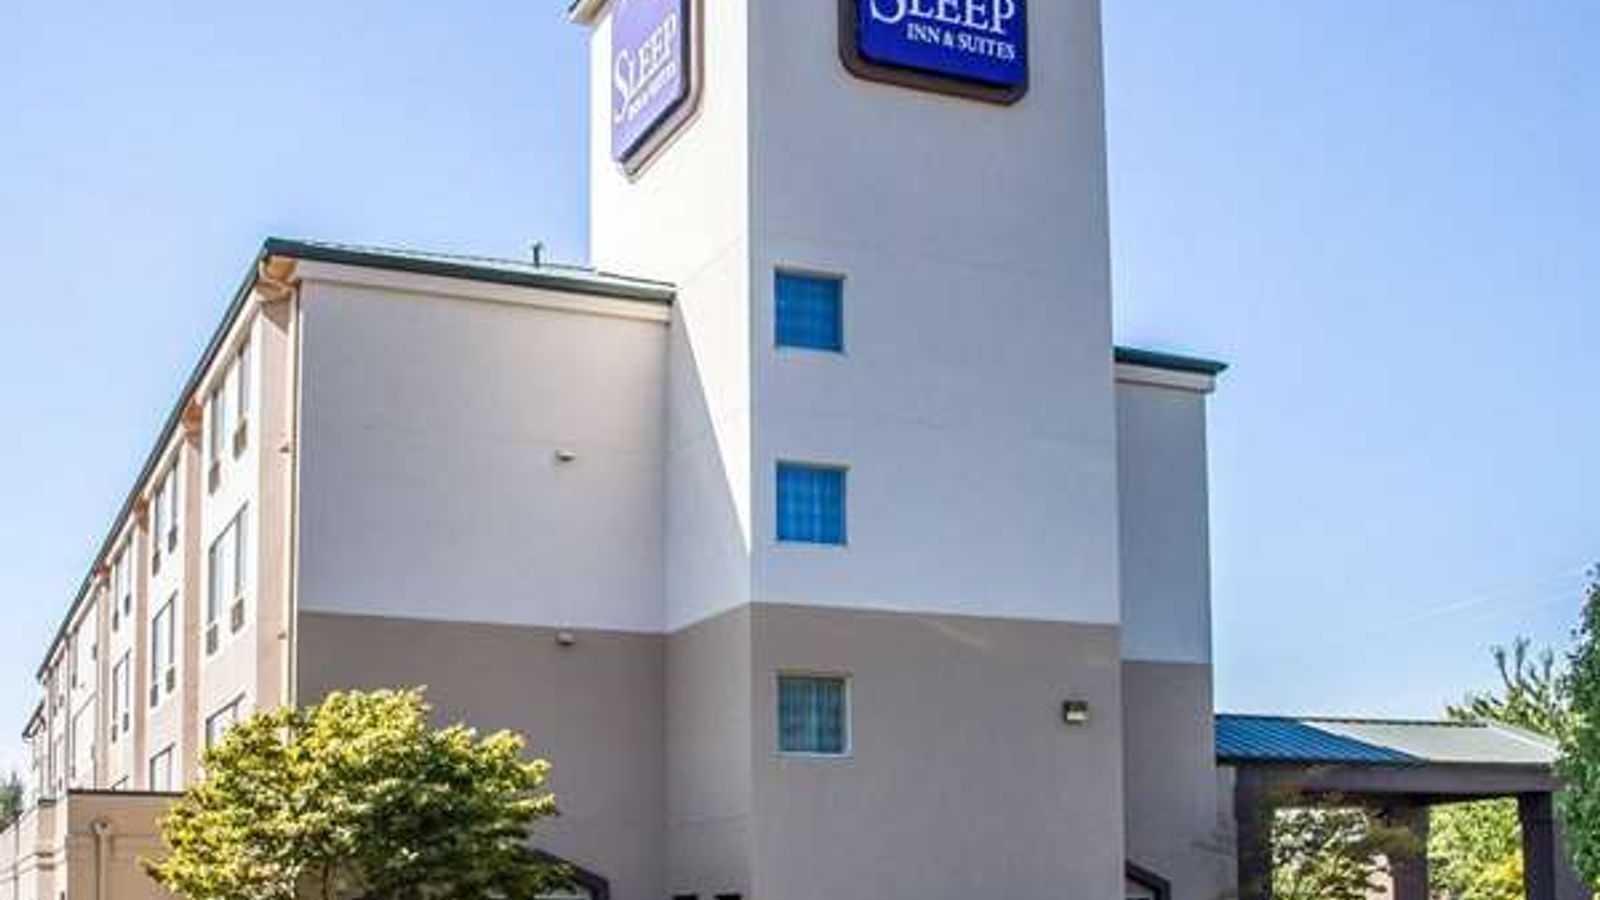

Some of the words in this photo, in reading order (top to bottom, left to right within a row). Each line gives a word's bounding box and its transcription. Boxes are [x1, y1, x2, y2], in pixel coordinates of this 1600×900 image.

[614, 12, 677, 124] SLEEP
[906, 23, 940, 46] INN
[957, 33, 1015, 60] SUITES
